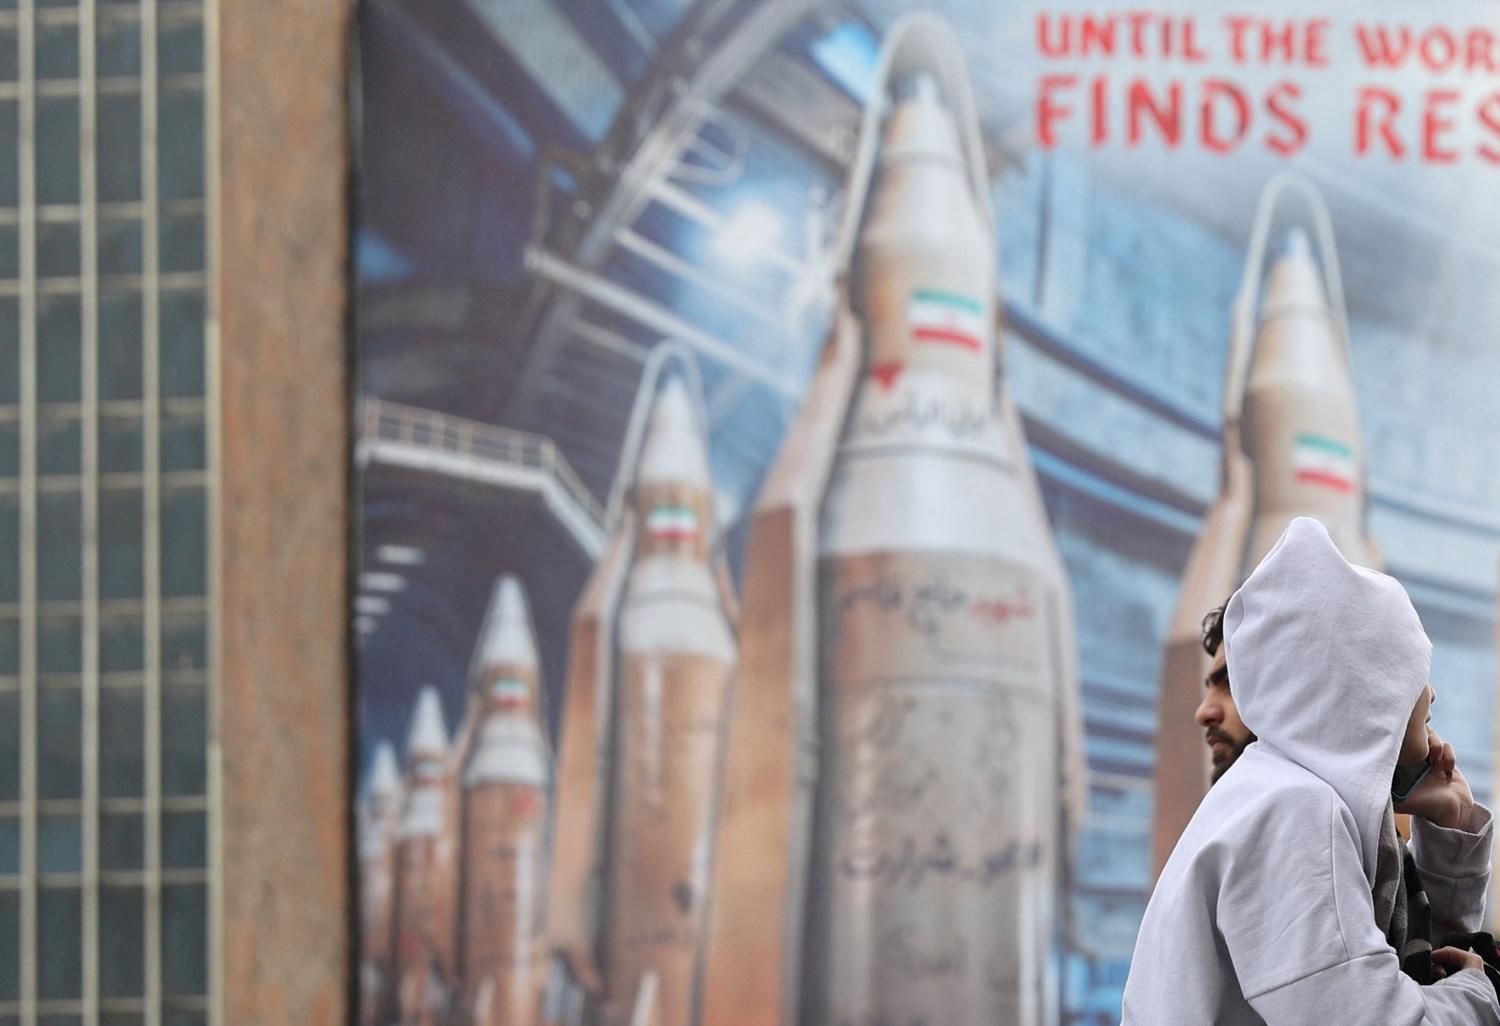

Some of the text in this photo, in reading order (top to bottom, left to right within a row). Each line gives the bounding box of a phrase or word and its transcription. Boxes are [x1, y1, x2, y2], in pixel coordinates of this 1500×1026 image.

[1035, 12, 1208, 62] UNTIL
[1224, 16, 1332, 68] THE
[1035, 75, 1310, 157] FINDS
